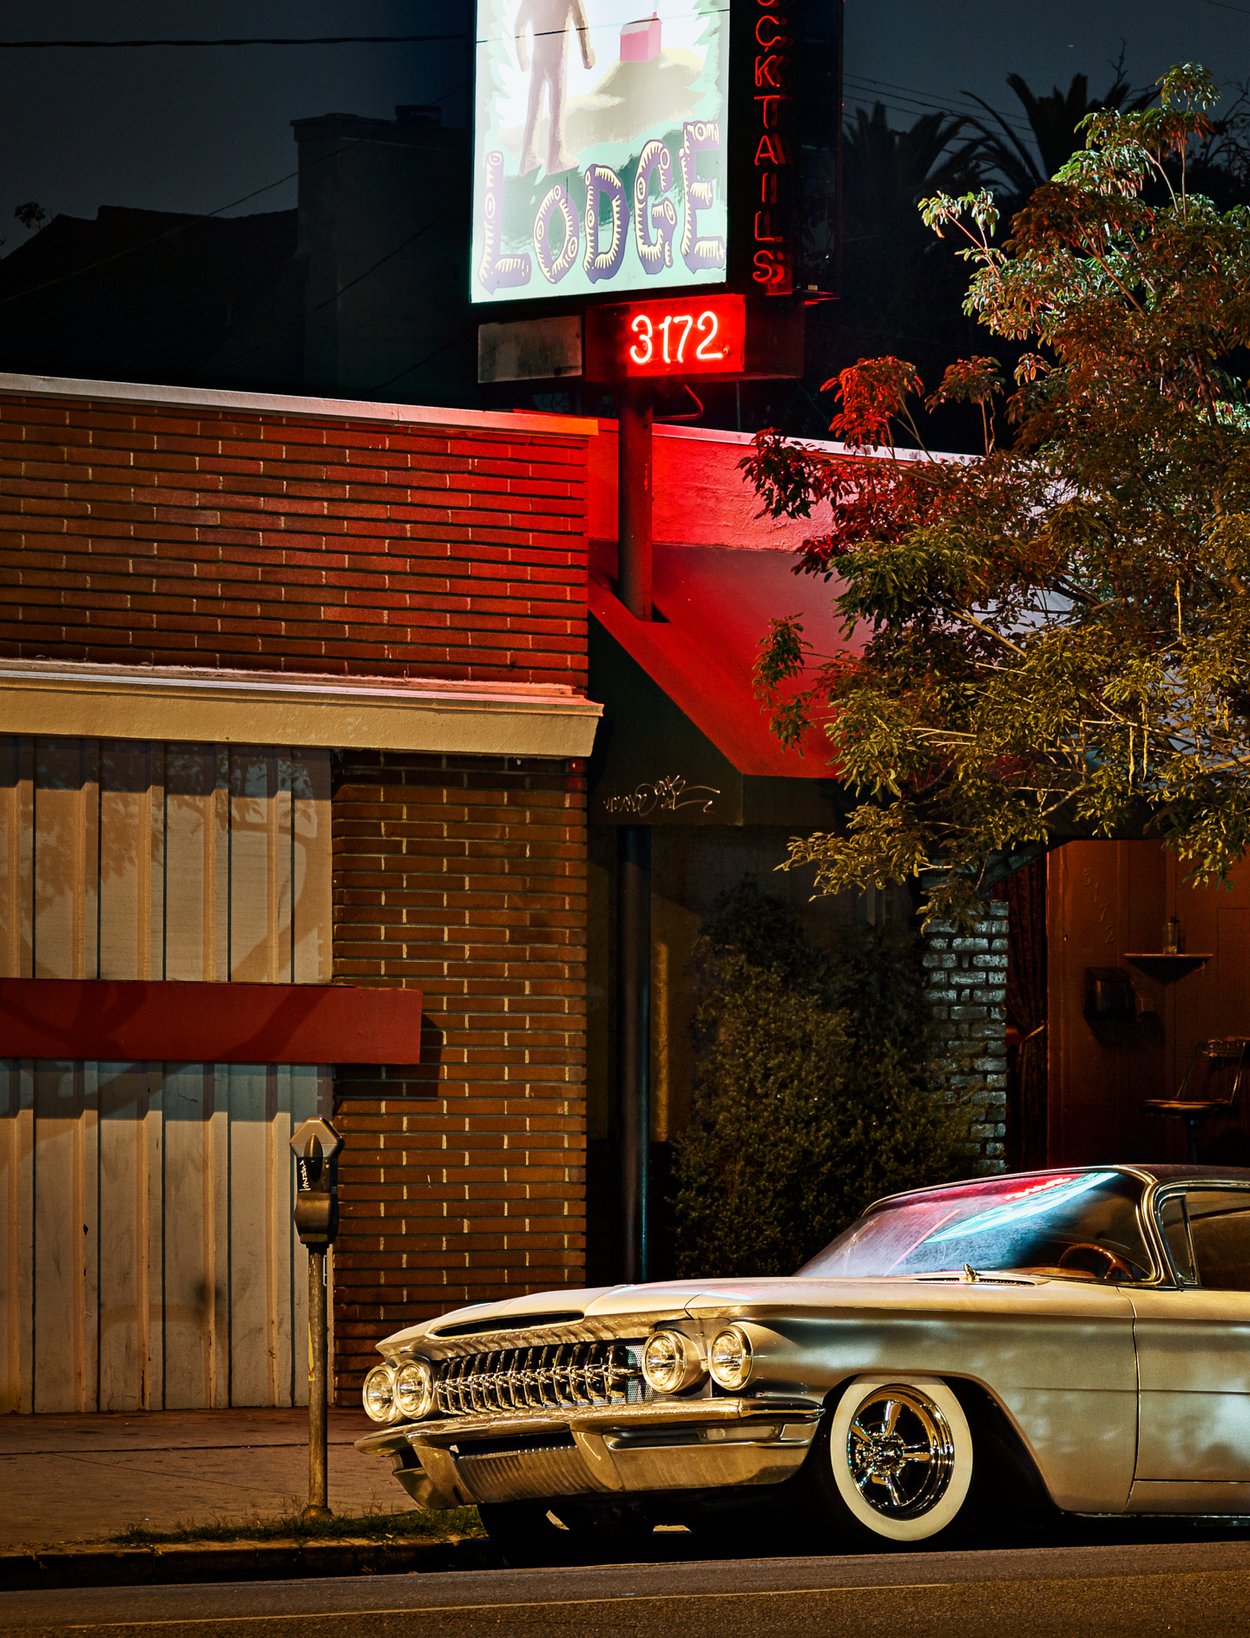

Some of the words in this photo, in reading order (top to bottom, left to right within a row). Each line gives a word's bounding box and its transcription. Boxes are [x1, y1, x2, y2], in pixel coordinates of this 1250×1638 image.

[478, 121, 725, 294] LODGE
[752, 0, 781, 283] CKTAILS
[629, 310, 724, 365] 3172
